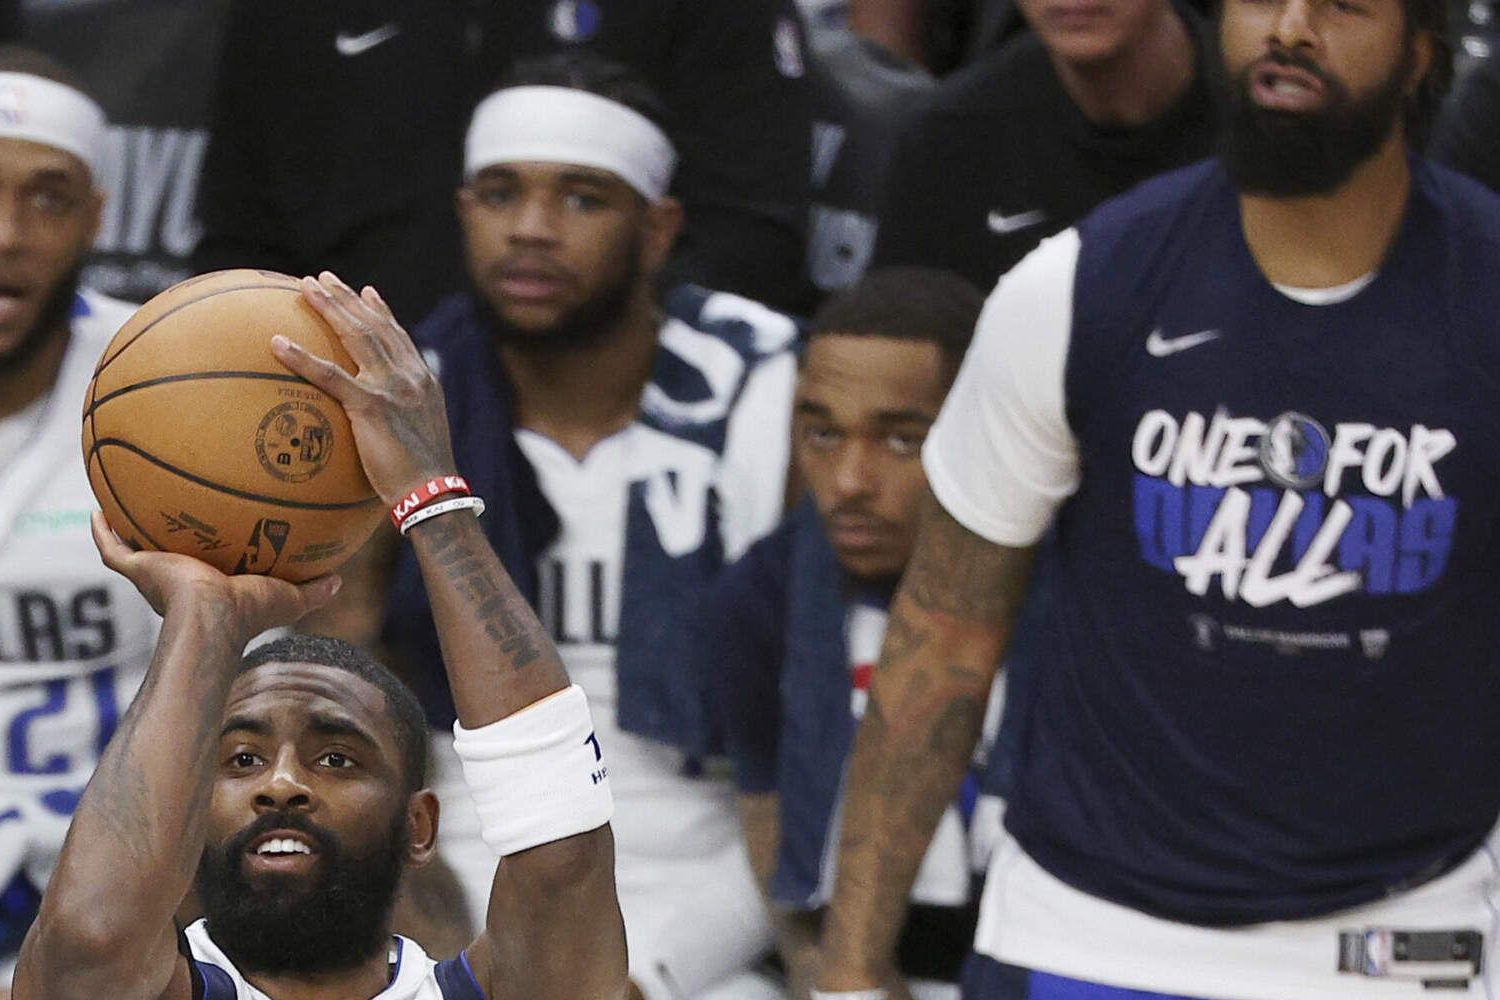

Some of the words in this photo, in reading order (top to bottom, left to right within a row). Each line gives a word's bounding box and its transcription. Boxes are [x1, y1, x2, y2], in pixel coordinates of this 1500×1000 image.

[1132, 405, 1268, 487] ONE
[1324, 423, 1457, 509] FOR
[1173, 486, 1361, 608] ALL
